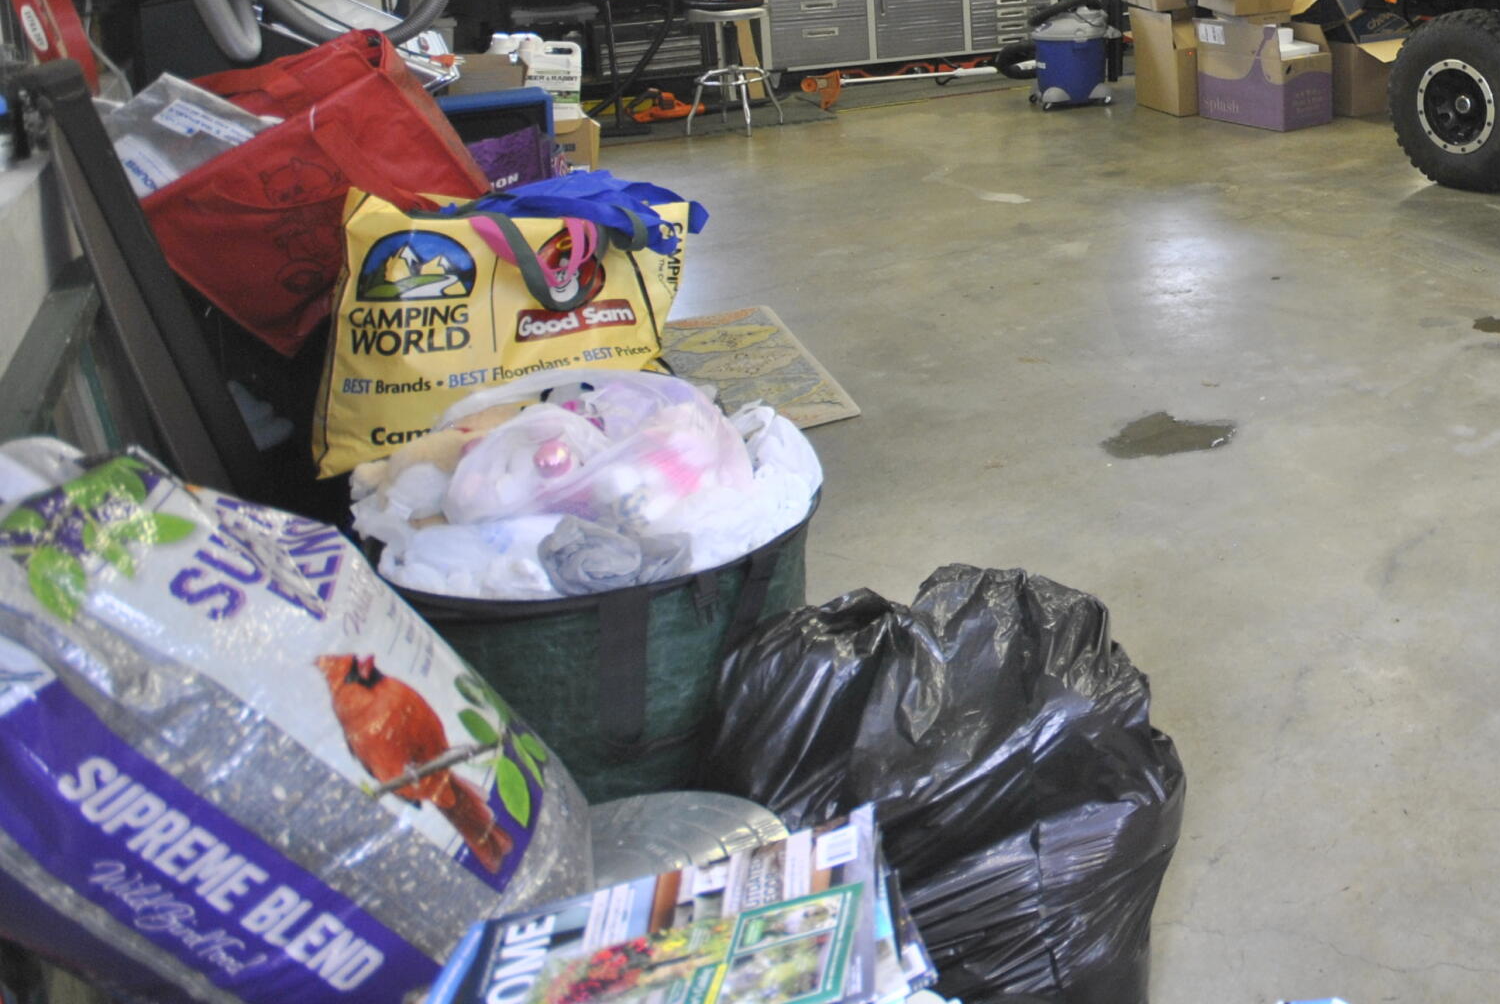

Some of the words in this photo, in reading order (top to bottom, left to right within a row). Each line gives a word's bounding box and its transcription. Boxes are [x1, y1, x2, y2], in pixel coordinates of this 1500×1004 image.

[349, 304, 469, 329] CAMPING
[518, 314, 580, 337] Good
[583, 306, 634, 324] Sam
[351, 326, 471, 356] WORLD
[343, 378, 372, 395] BEST
[375, 377, 431, 395] Brands
[448, 368, 488, 389] BEST
[492, 355, 570, 383] Floorplans
[582, 347, 613, 362] BEST
[616, 346, 651, 357] Prices
[58, 757, 270, 913] SUPREME
[239, 885, 385, 992] BLEND
[486, 914, 557, 1004] OME
